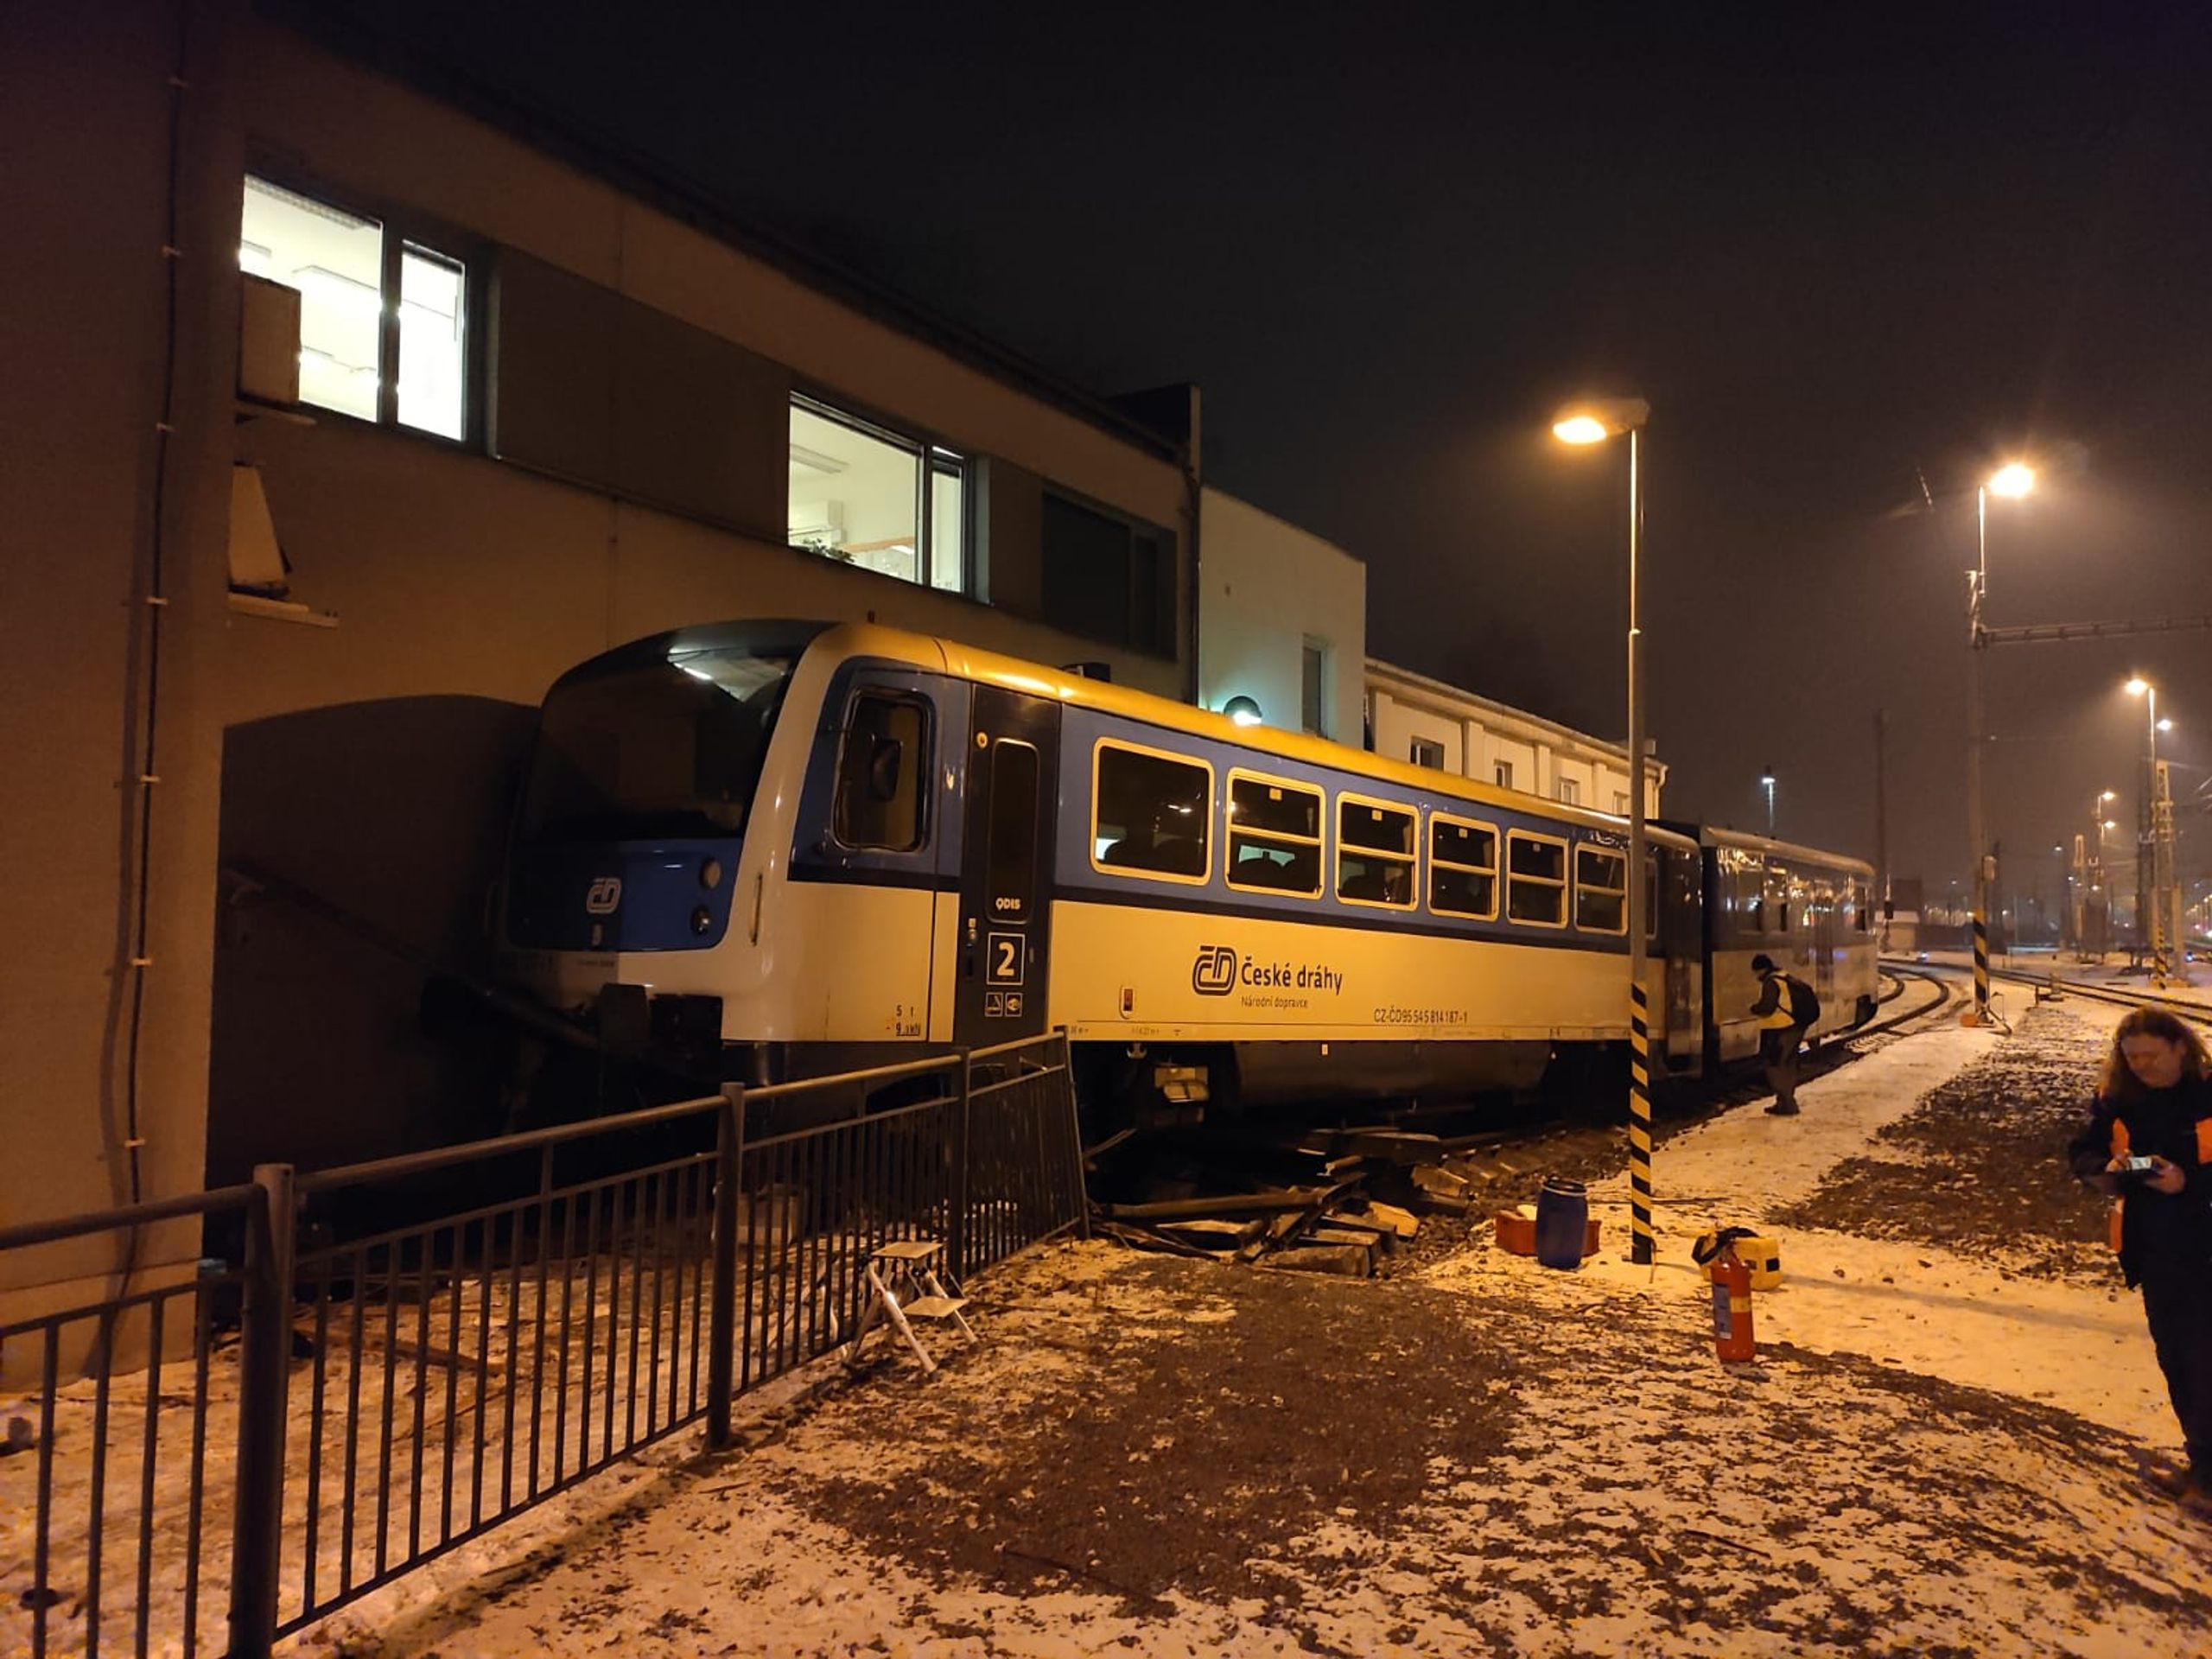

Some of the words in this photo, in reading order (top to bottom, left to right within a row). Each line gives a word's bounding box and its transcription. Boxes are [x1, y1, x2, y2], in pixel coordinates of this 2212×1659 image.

[995, 897, 1020, 910] ODIS
[996, 941, 1015, 976] 2
[1241, 956, 1292, 988] České
[1297, 964, 1343, 995] dráhy
[1241, 995, 1274, 1008] Národní
[1274, 996, 1309, 1010] dopravce
